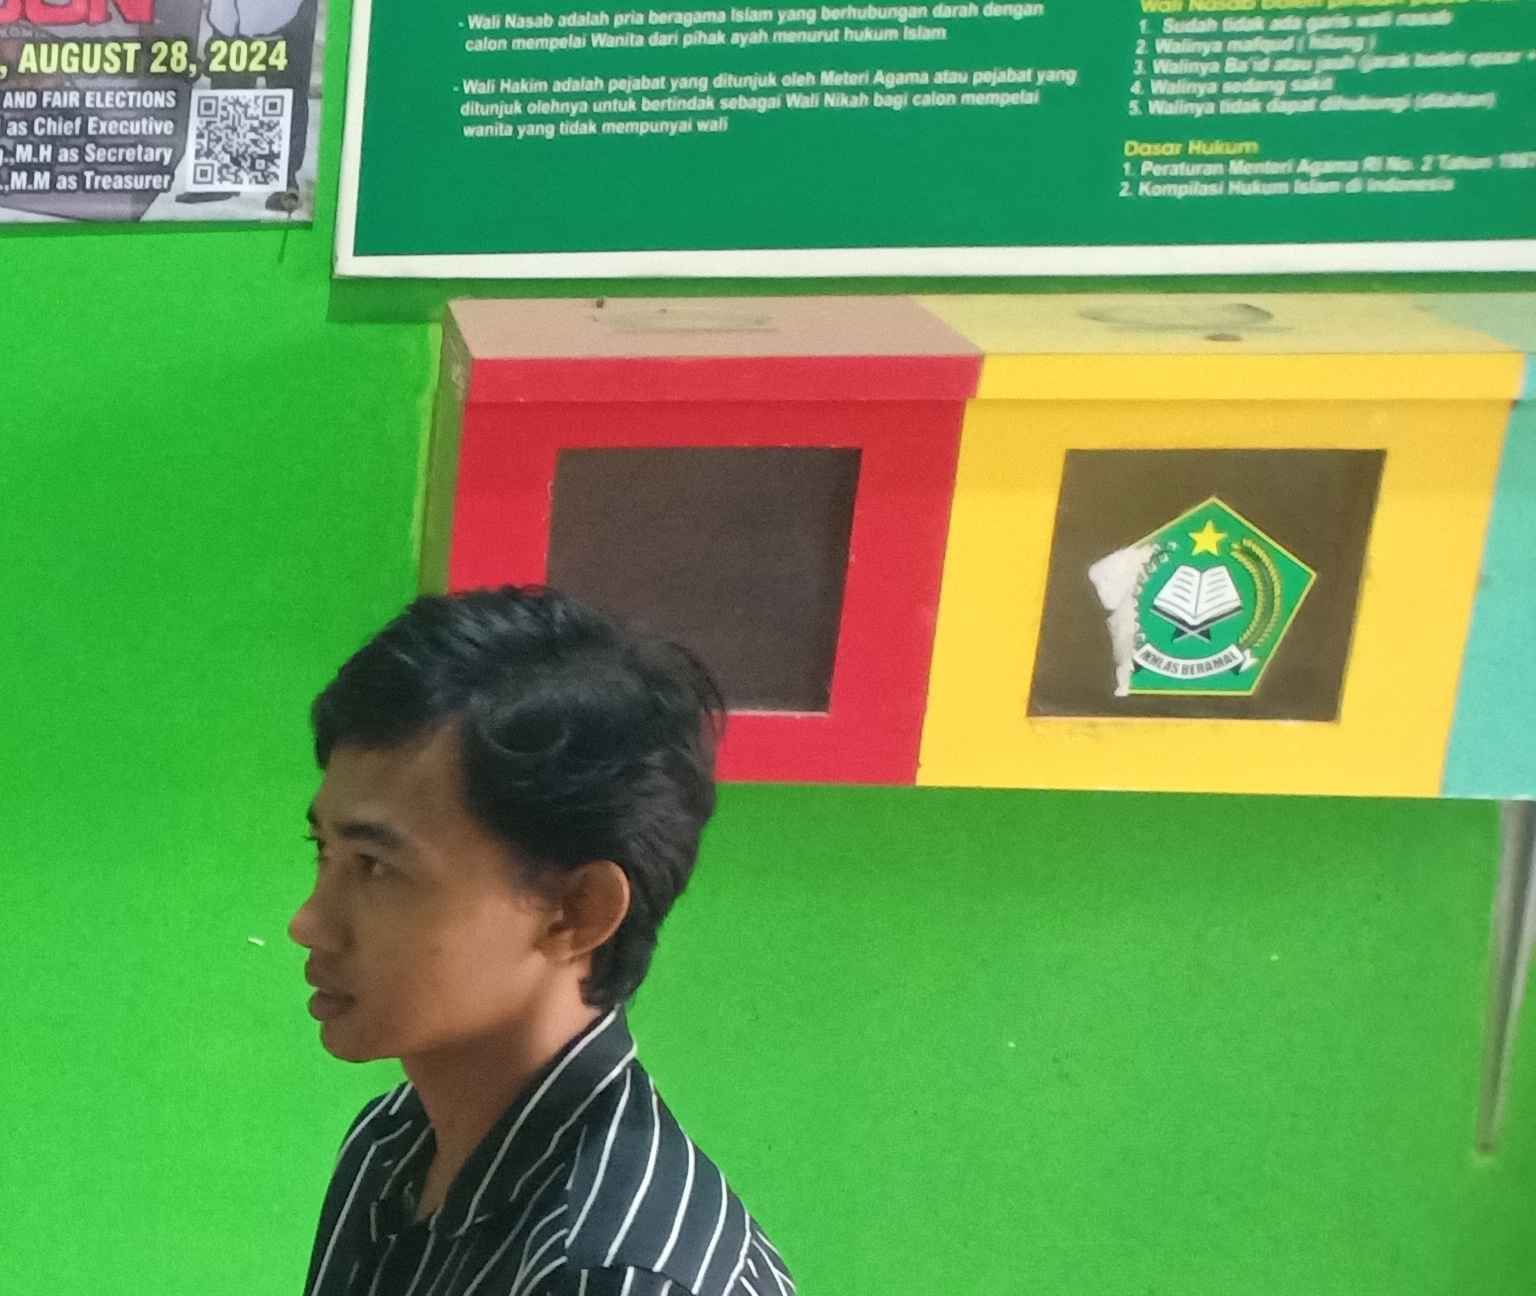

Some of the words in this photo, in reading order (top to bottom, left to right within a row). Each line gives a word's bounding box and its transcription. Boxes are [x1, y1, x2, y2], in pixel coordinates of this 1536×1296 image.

[467, 15, 501, 30] Wali
[505, 13, 554, 29] Nasab
[558, 11, 609, 28] adalah
[613, 11, 644, 29] pria
[648, 9, 726, 28] beragama
[731, 6, 773, 23] Islam
[778, 7, 817, 25] yang
[821, 5, 927, 23] berhubungan
[932, 2, 978, 18] darah
[982, 1, 1044, 20] dengan
[465, 37, 507, 52] calon
[512, 34, 586, 52] mempelai
[591, 33, 644, 48] Wanita
[648, 32, 678, 47] dari
[683, 31, 726, 48] pihak
[731, 29, 768, 47] ayah
[773, 28, 840, 44] menurut
[844, 26, 898, 42] hukum
[903, 25, 947, 40] Islam
[18, 42, 141, 74] AUGUST
[150, 41, 197, 77] 28,
[208, 40, 288, 73] 2024
[462, 80, 495, 94] Wali
[500, 78, 548, 93] Hakim
[552, 77, 604, 92] adalah
[608, 75, 666, 94] pejabat
[670, 77, 708, 92] yang
[712, 72, 777, 90] ditunjuk
[781, 71, 815, 87] oleh
[820, 69, 869, 86] Meteri
[873, 70, 929, 89] Agama
[934, 70, 968, 83] atau
[972, 68, 1032, 86] pejabat
[1036, 69, 1078, 85] yang
[3, 91, 37, 109] AND
[42, 91, 80, 108] FAIR
[85, 90, 176, 108] ELECTIONS
[460, 102, 522, 119] ditunjuk
[527, 100, 588, 117] olehnya
[593, 98, 636, 112] untuk
[641, 97, 715, 112] bertindak
[719, 95, 781, 113] sebagai
[786, 93, 819, 109] Wali
[824, 93, 869, 108] Nikah
[873, 92, 908, 110] bagi
[912, 91, 957, 106] calon
[961, 89, 1040, 107] mempelai
[6, 121, 28, 136] as
[33, 117, 82, 137] Chief
[88, 116, 175, 135] Executive
[463, 122, 513, 137] wanita
[517, 124, 555, 139] yang
[559, 120, 597, 135] tidak
[601, 119, 693, 136] mempunyai
[696, 117, 728, 132] wali
[58, 147, 79, 162] as
[84, 143, 173, 166] Secretary
[1124, 140, 1183, 157] Dasar
[1188, 139, 1260, 155] Hukum
[1141, 160, 1225, 177] Peraturan
[56, 175, 78, 190] as
[85, 171, 171, 190] Treasurer
